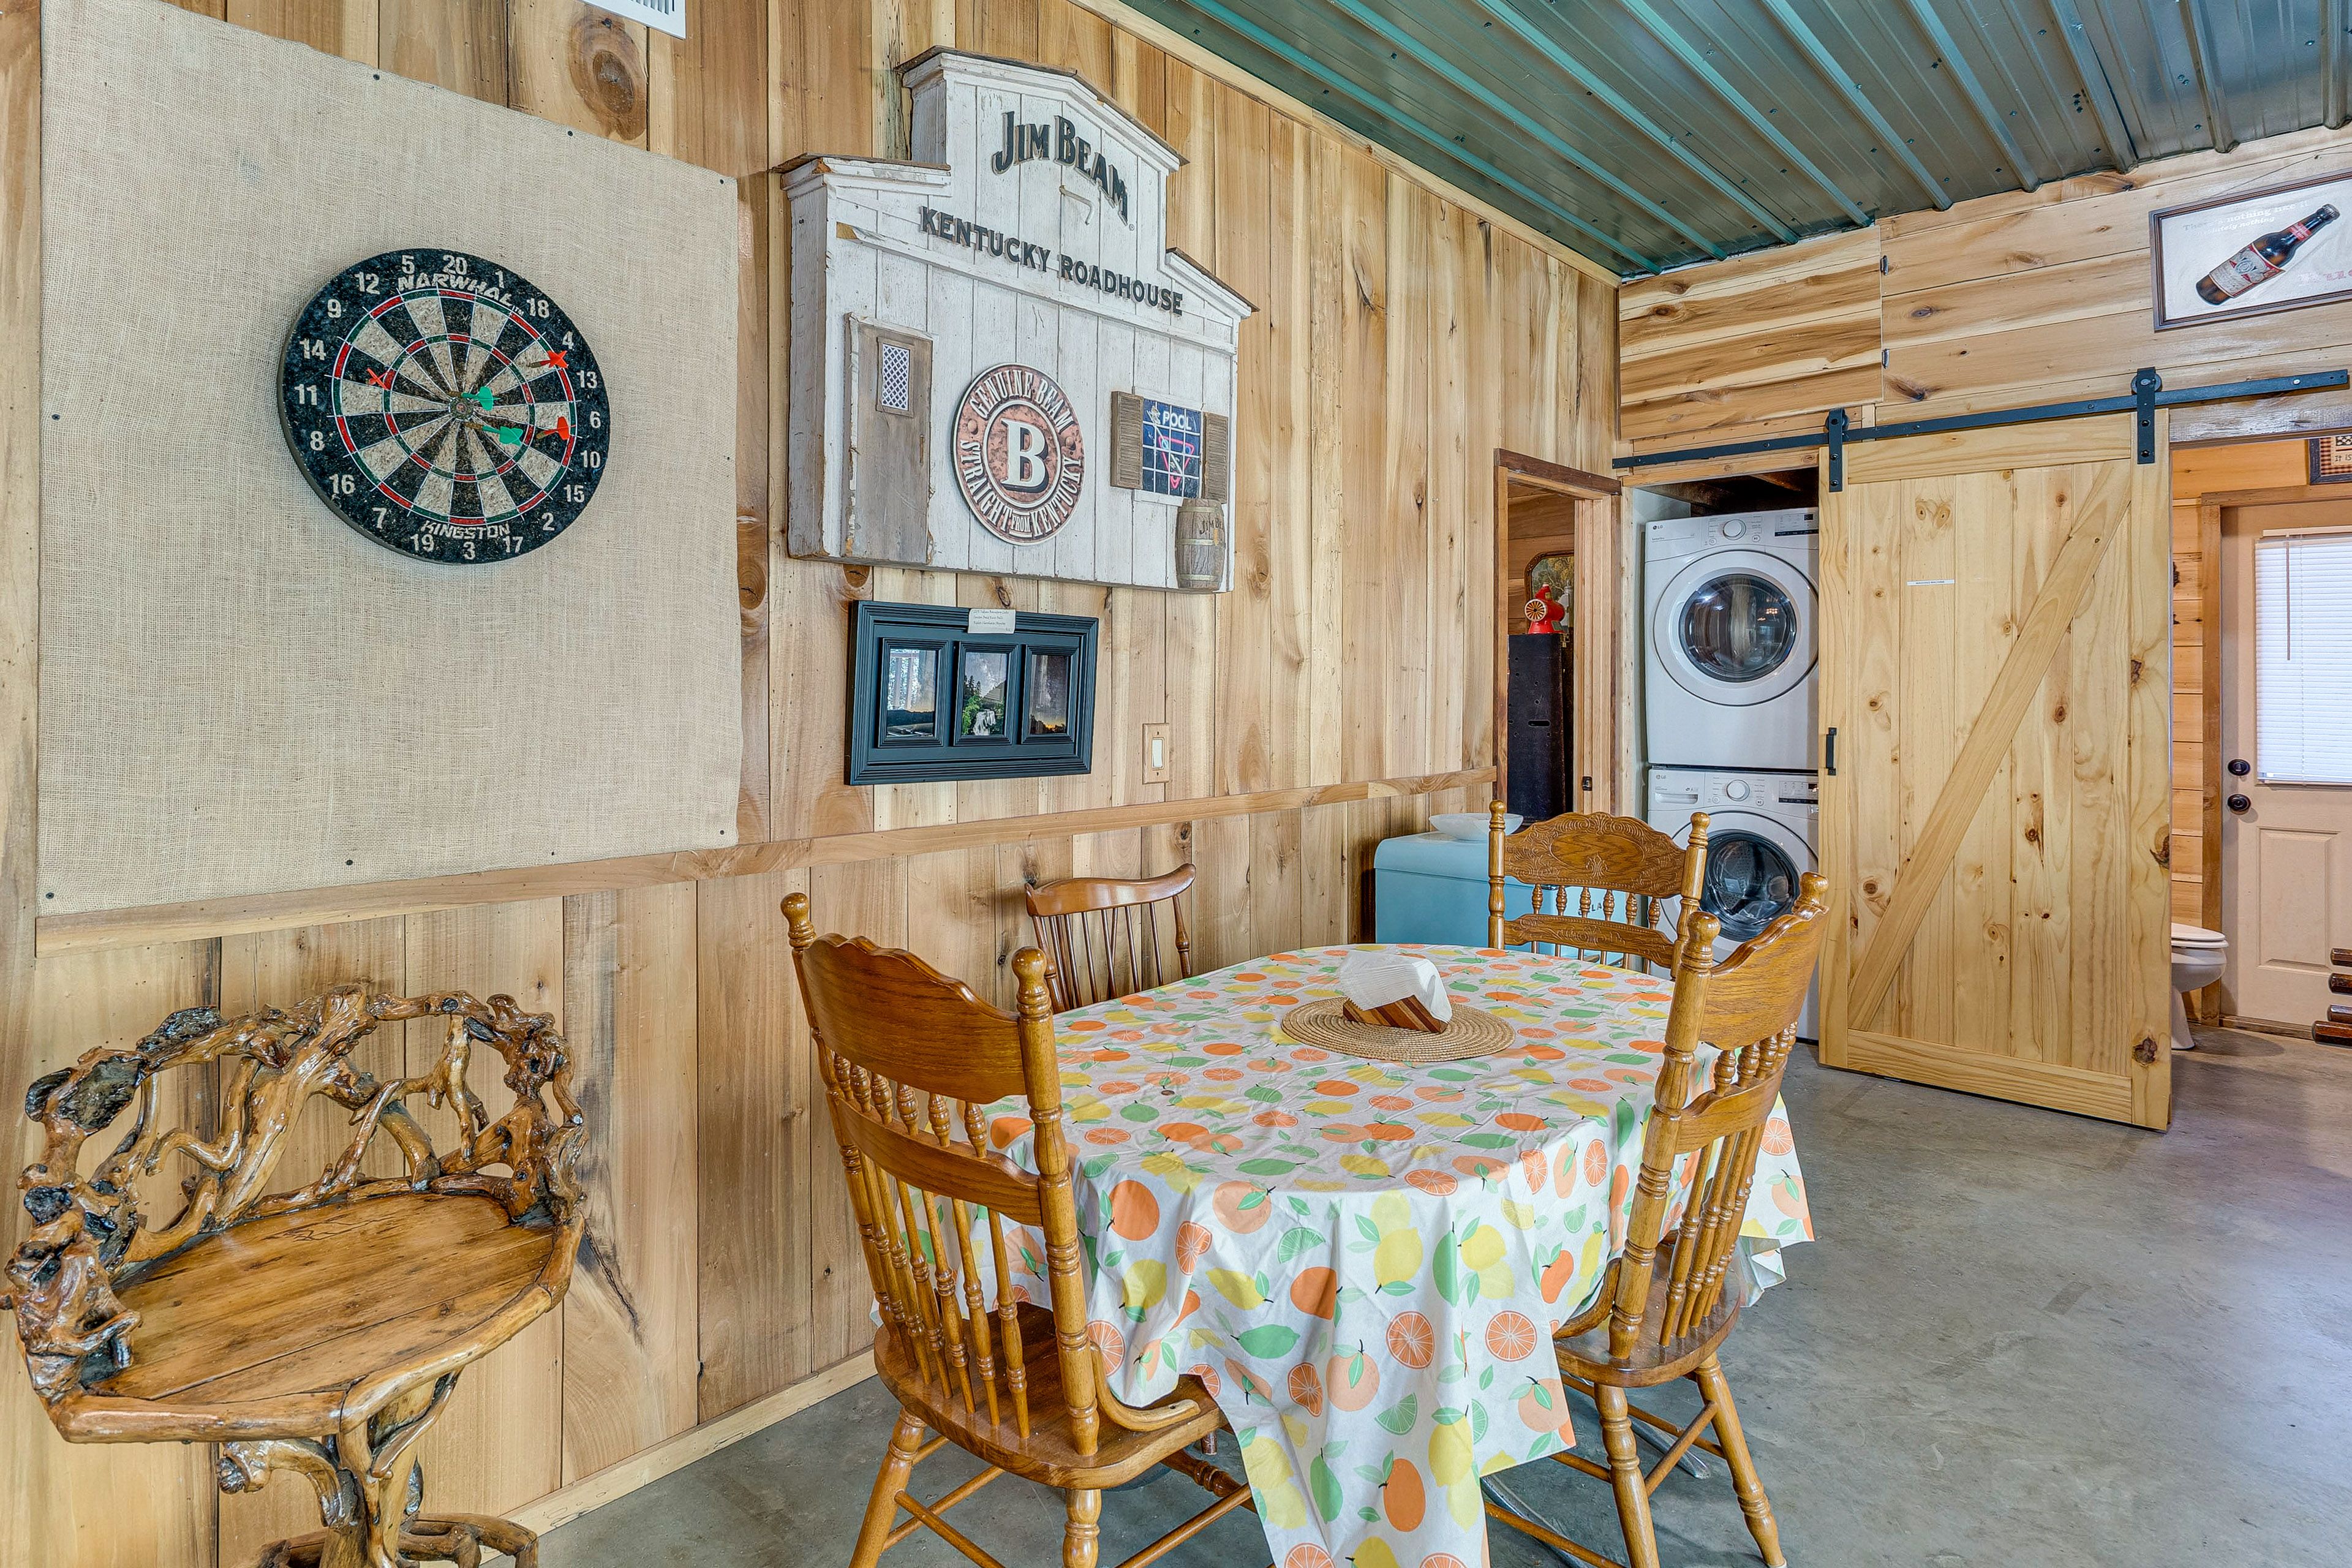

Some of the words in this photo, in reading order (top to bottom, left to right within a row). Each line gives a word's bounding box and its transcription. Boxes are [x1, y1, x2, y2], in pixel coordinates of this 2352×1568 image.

[992, 111, 1050, 175] JIM
[1054, 115, 1128, 225] BEAM
[401, 255, 415, 274] 5
[443, 255, 468, 276] 20
[919, 206, 1051, 273] KENTUCKY
[1058, 254, 1183, 316] ROADHOUSE
[354, 271, 380, 295] 12
[398, 272, 513, 306] NARWHAL
[495, 270, 505, 288] 1
[327, 299, 342, 318] 9
[527, 298, 550, 318] 18
[300, 338, 327, 361] 14
[562, 331, 575, 350] 4
[576, 370, 598, 389] 13
[295, 383, 317, 405] 11
[969, 369, 1034, 420] GENUINE
[1035, 378, 1074, 434] BEAM
[590, 411, 601, 429] 6
[1163, 410, 1192, 431] POOL
[310, 431, 325, 451] 8
[581, 450, 601, 469] 10
[1000, 418, 1049, 493] B
[329, 473, 356, 495] 16
[564, 484, 585, 503] 15
[960, 439, 1012, 532] STRAIGHT
[1011, 516, 1031, 533] FROM
[1030, 456, 1082, 538] KENTUCKY
[372, 507, 387, 529] 7
[541, 513, 555, 531] 2
[420, 520, 510, 539] KINGSTON
[410, 533, 434, 552] 19
[463, 541, 475, 560] 3
[503, 536, 523, 554] 17
